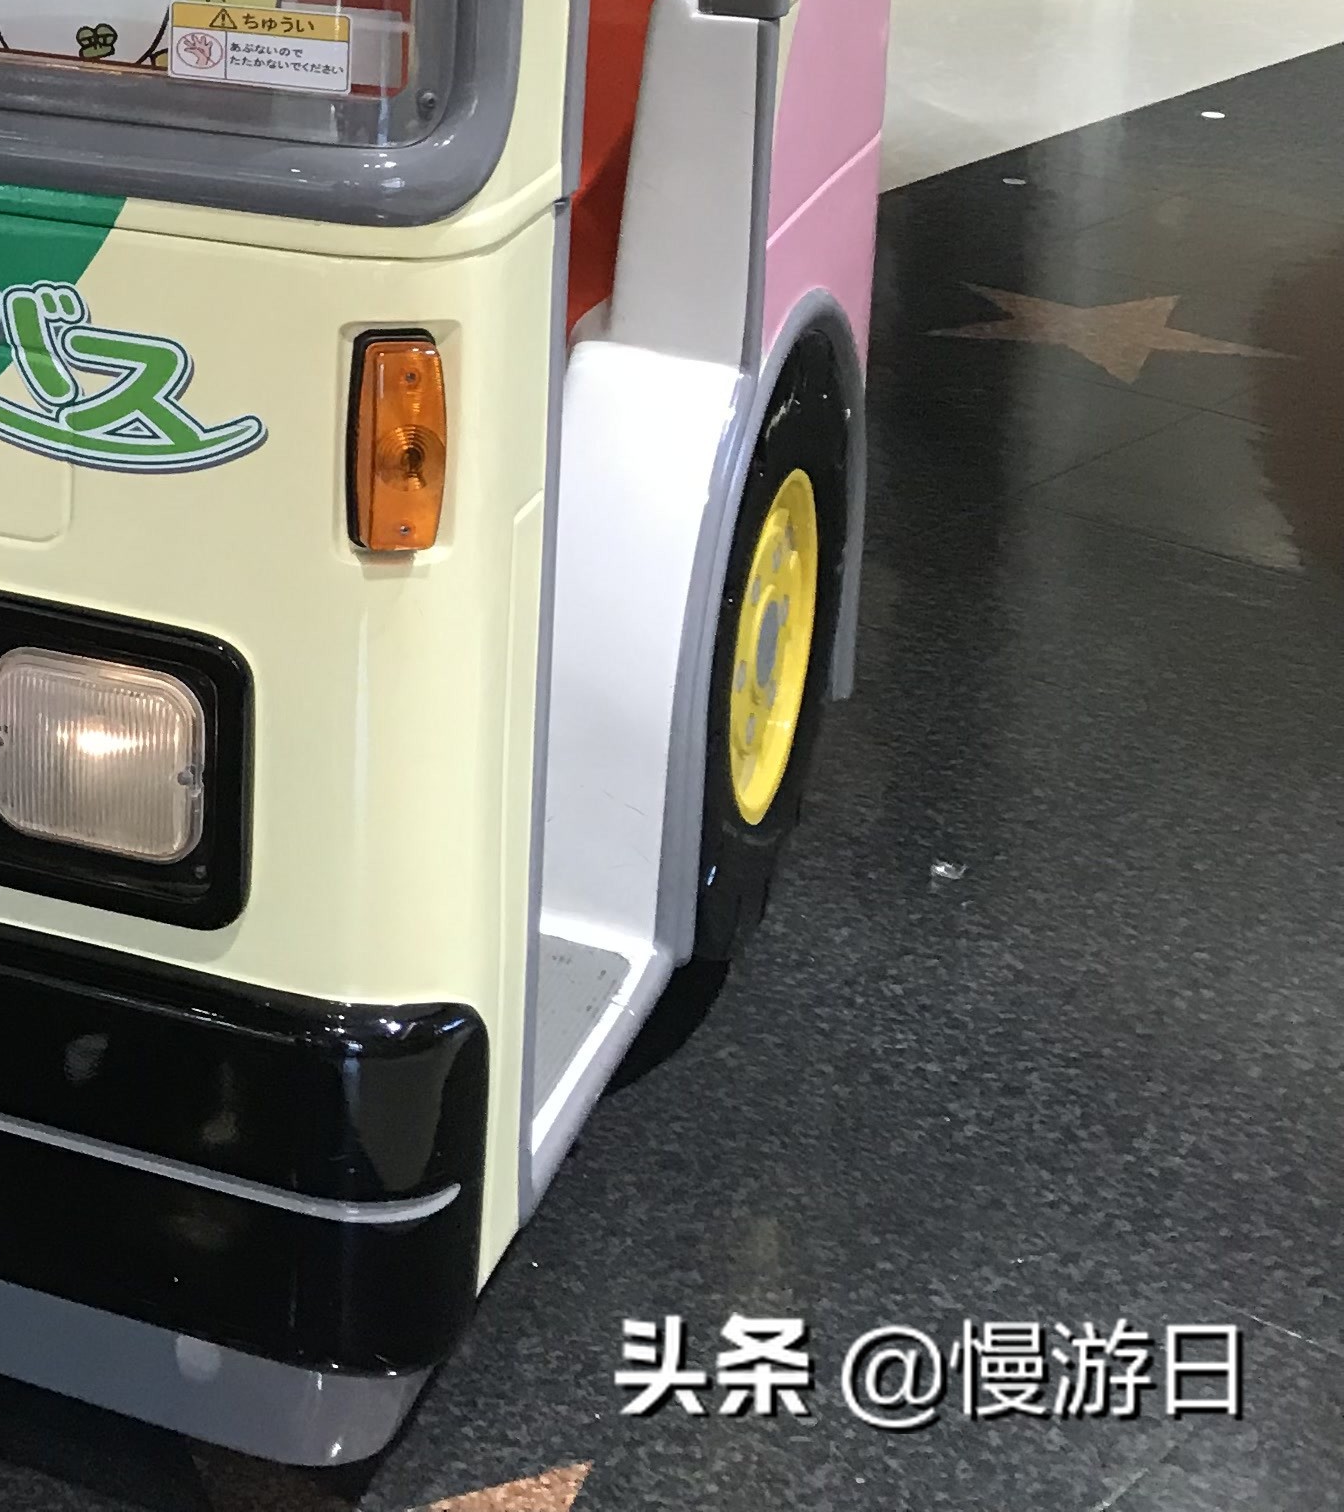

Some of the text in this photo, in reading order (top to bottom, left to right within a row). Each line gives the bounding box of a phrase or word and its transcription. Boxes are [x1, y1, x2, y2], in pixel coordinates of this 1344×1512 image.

[242, 13, 315, 33] ちゅうい
[229, 42, 304, 57] あぶないので
[229, 56, 344, 75] たたかないでください
